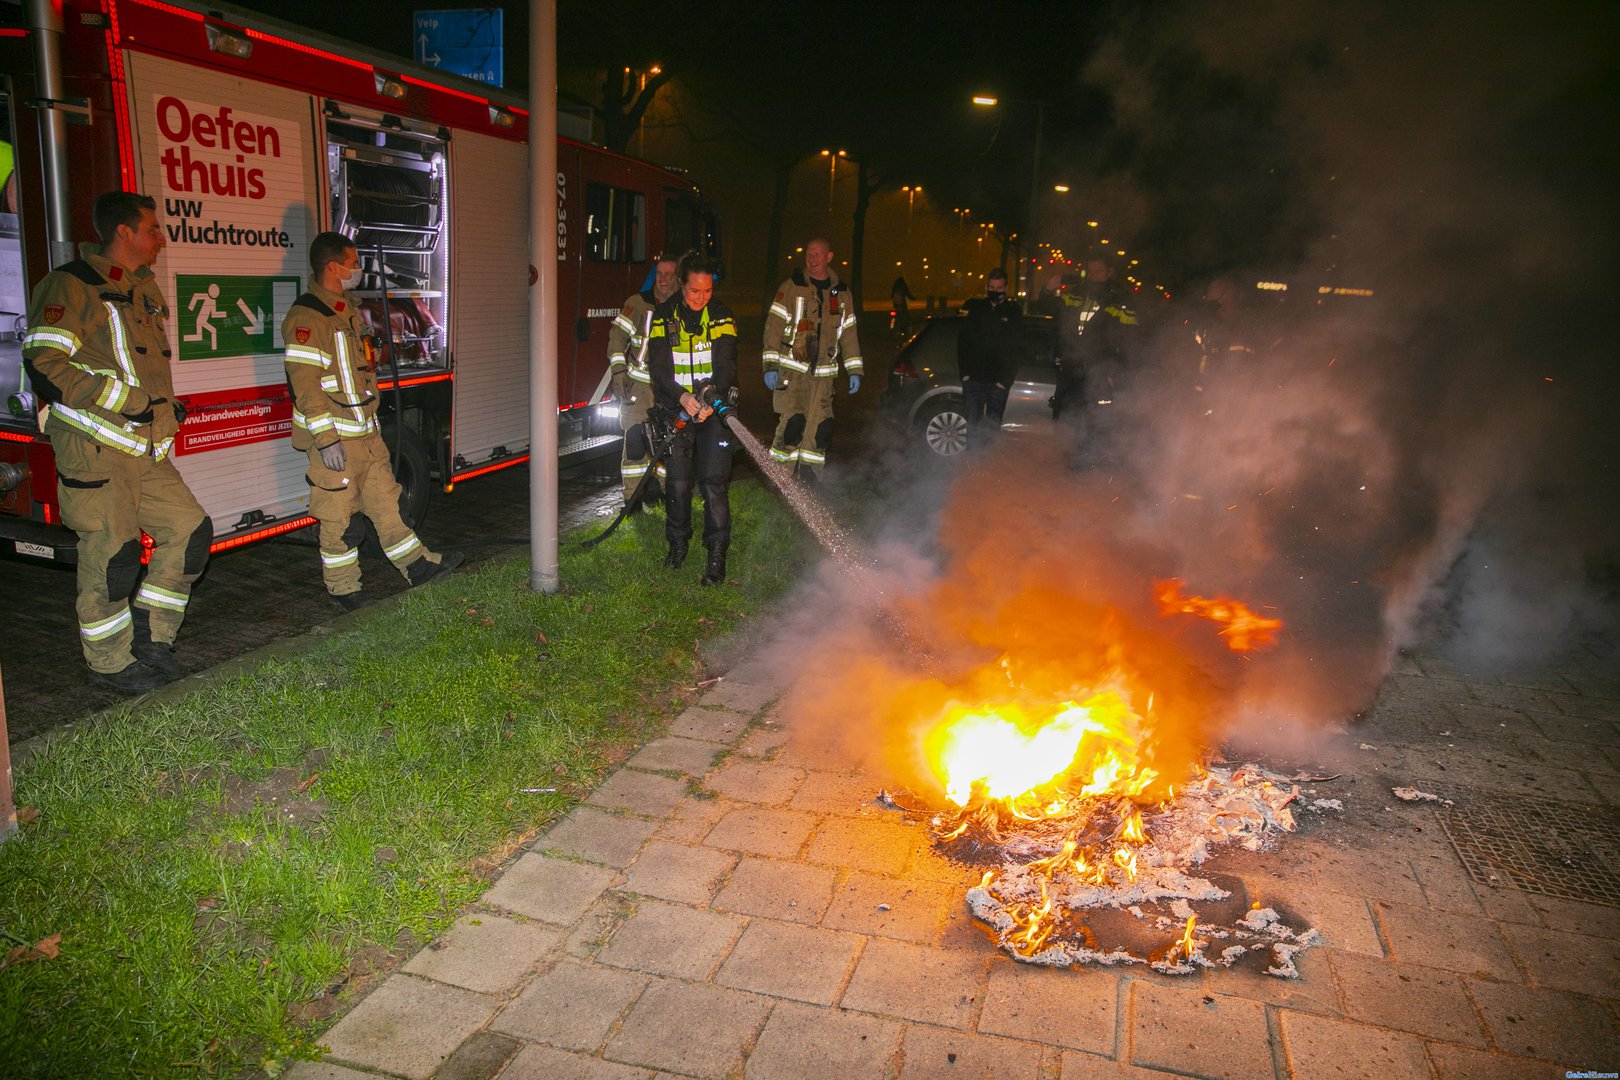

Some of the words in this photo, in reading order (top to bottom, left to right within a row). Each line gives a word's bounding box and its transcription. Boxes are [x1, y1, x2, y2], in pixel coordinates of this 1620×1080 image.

[417, 19, 438, 29] Velp
[156, 96, 281, 158] Oefen
[161, 145, 266, 200] thuis
[165, 198, 203, 218] uw
[556, 172, 567, 262] 07-3631
[166, 218, 294, 248] vluchtroute.
[189, 430, 245, 445] BRANDVEILIGHEID
[246, 425, 268, 436] BEGINT
[278, 421, 293, 430] JEZEL
